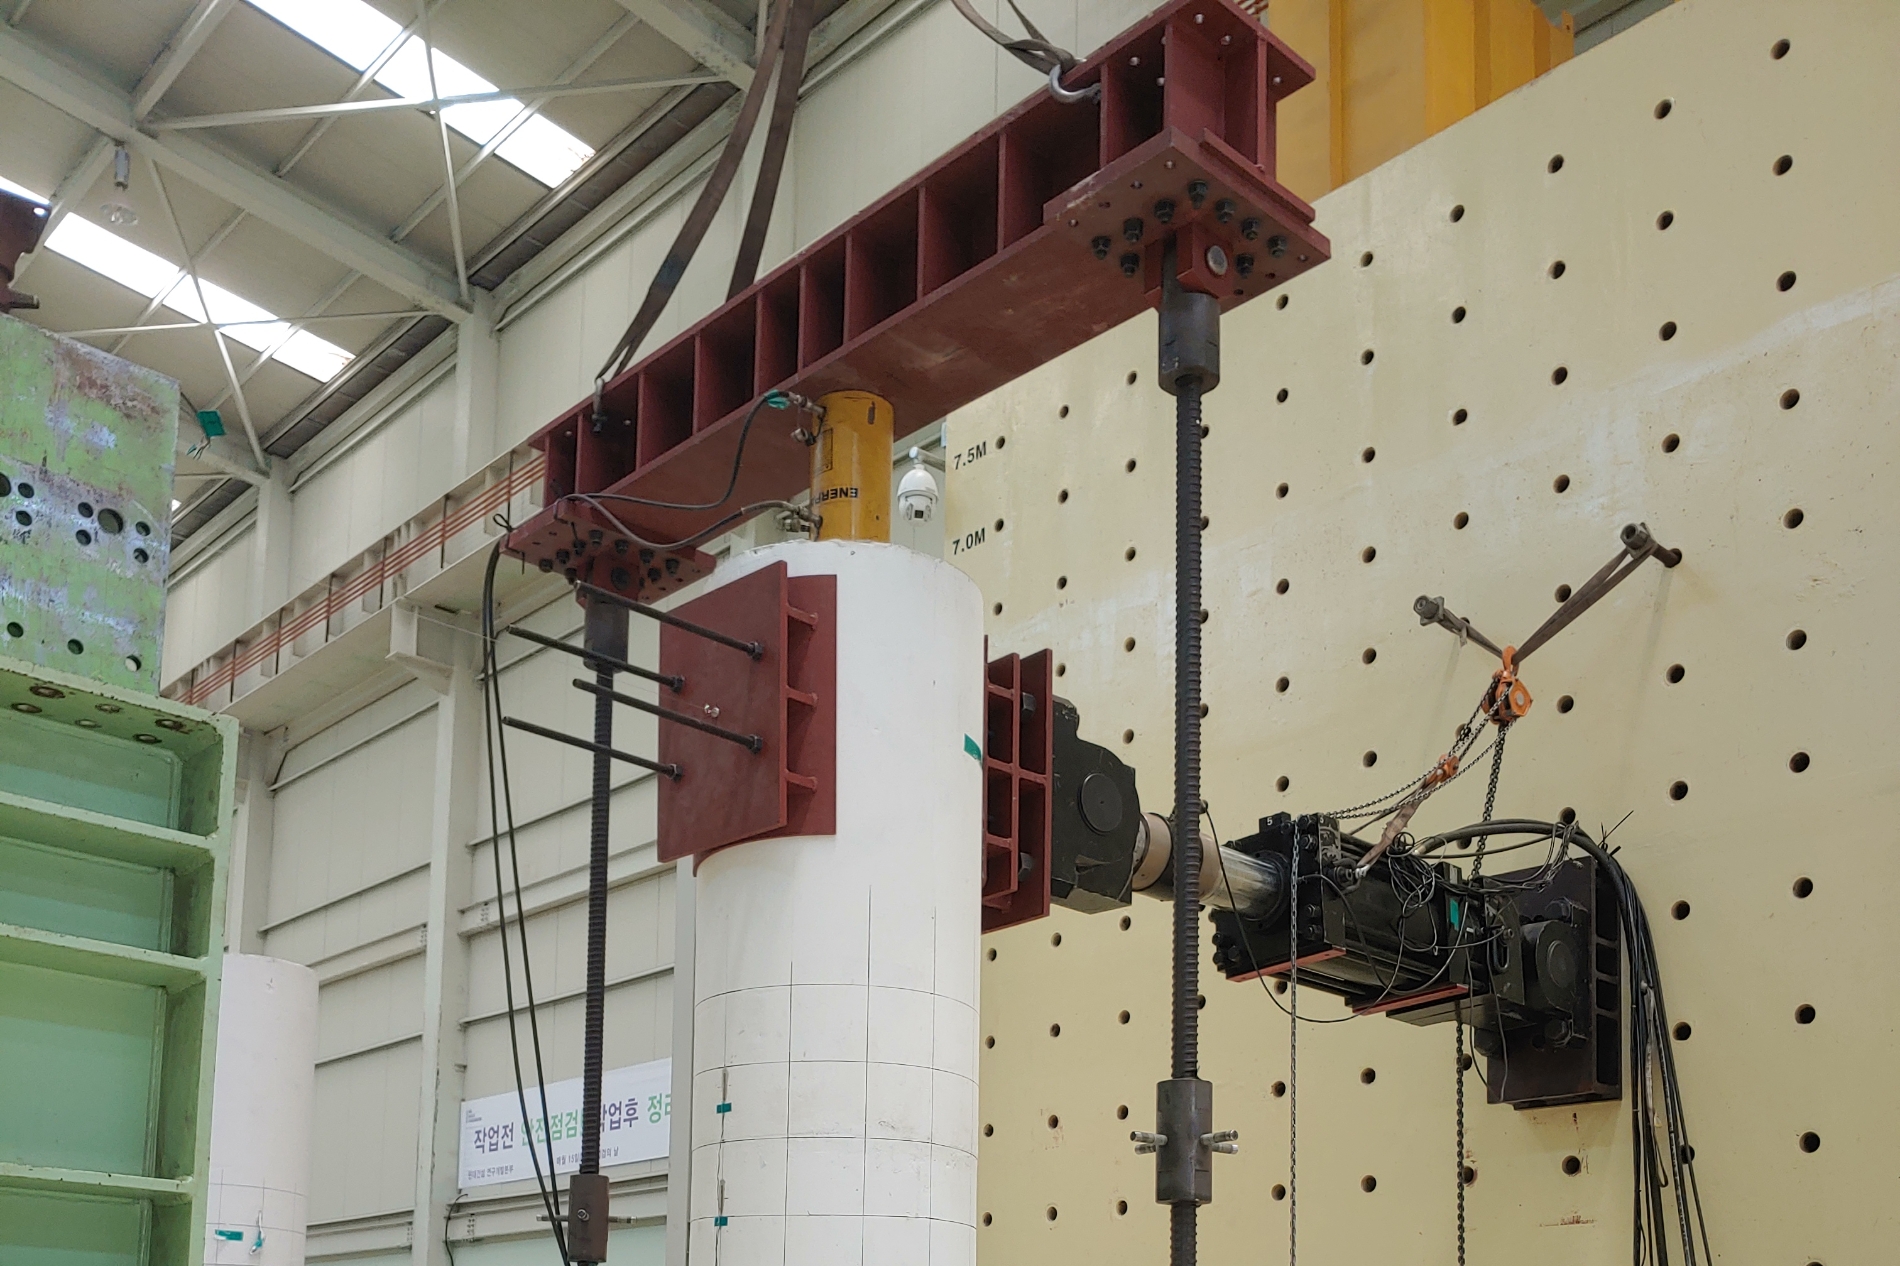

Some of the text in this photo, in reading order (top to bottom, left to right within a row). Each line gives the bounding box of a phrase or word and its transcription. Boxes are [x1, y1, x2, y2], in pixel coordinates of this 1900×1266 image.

[953, 440, 987, 470] 7.5M
[952, 527, 986, 555] 7.0M
[1266, 816, 1273, 826] 5
[473, 1121, 514, 1154] 작업전
